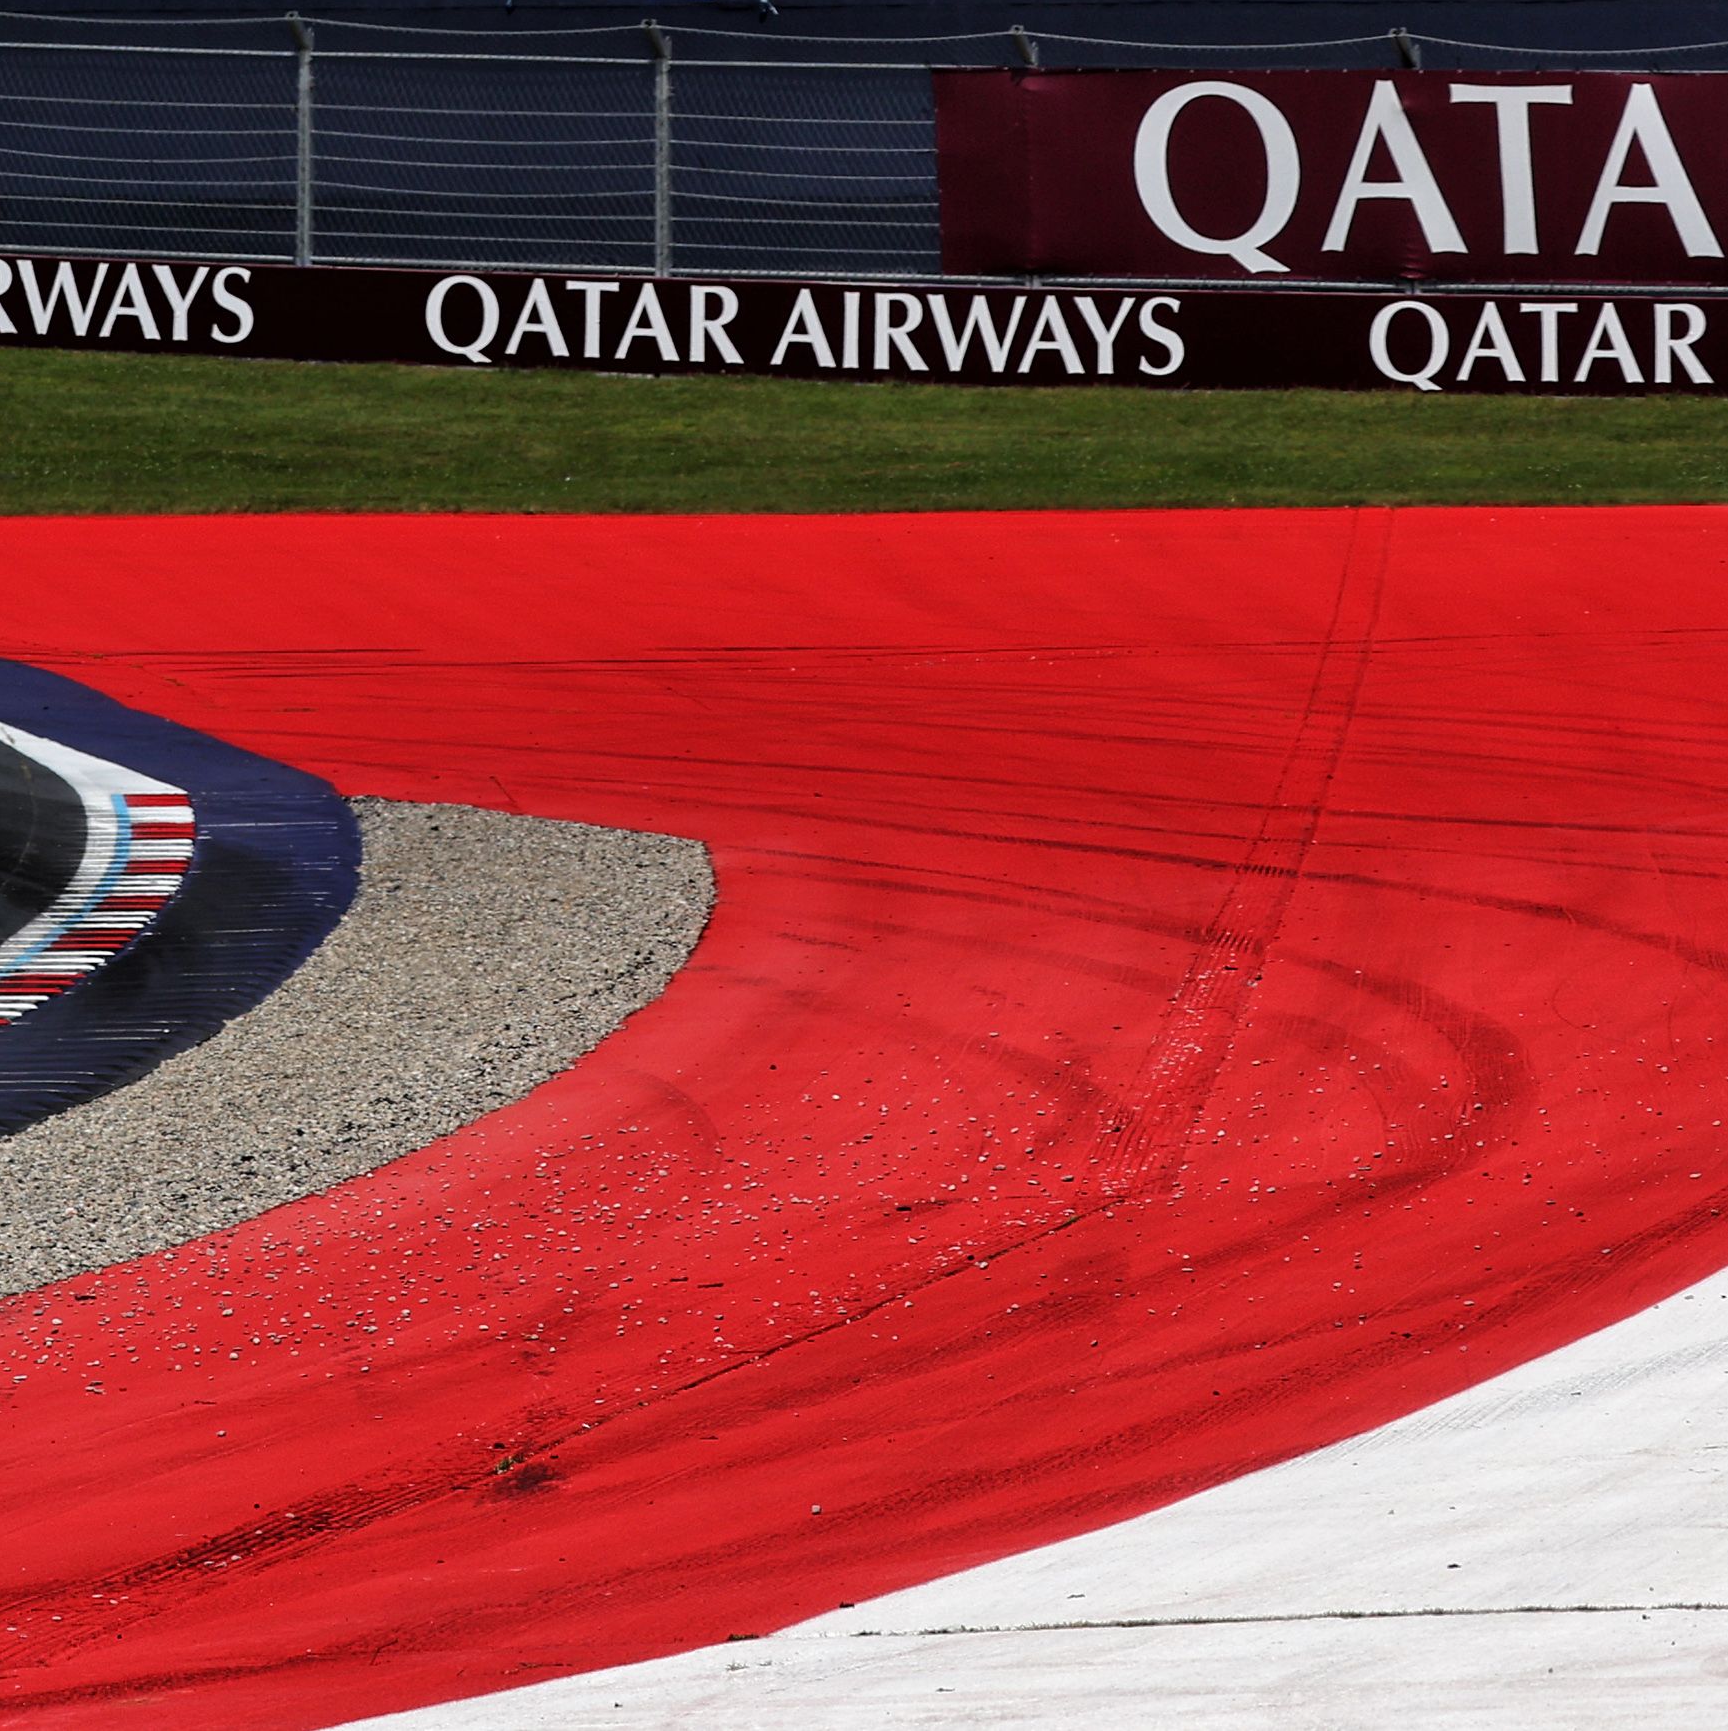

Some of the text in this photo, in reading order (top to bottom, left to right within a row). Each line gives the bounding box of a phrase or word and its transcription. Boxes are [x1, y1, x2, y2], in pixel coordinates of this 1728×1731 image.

[1134, 80, 1724, 274] QATA
[425, 275, 1185, 376] QATAR AIRWAYS
[1369, 300, 1715, 391] QATAR
